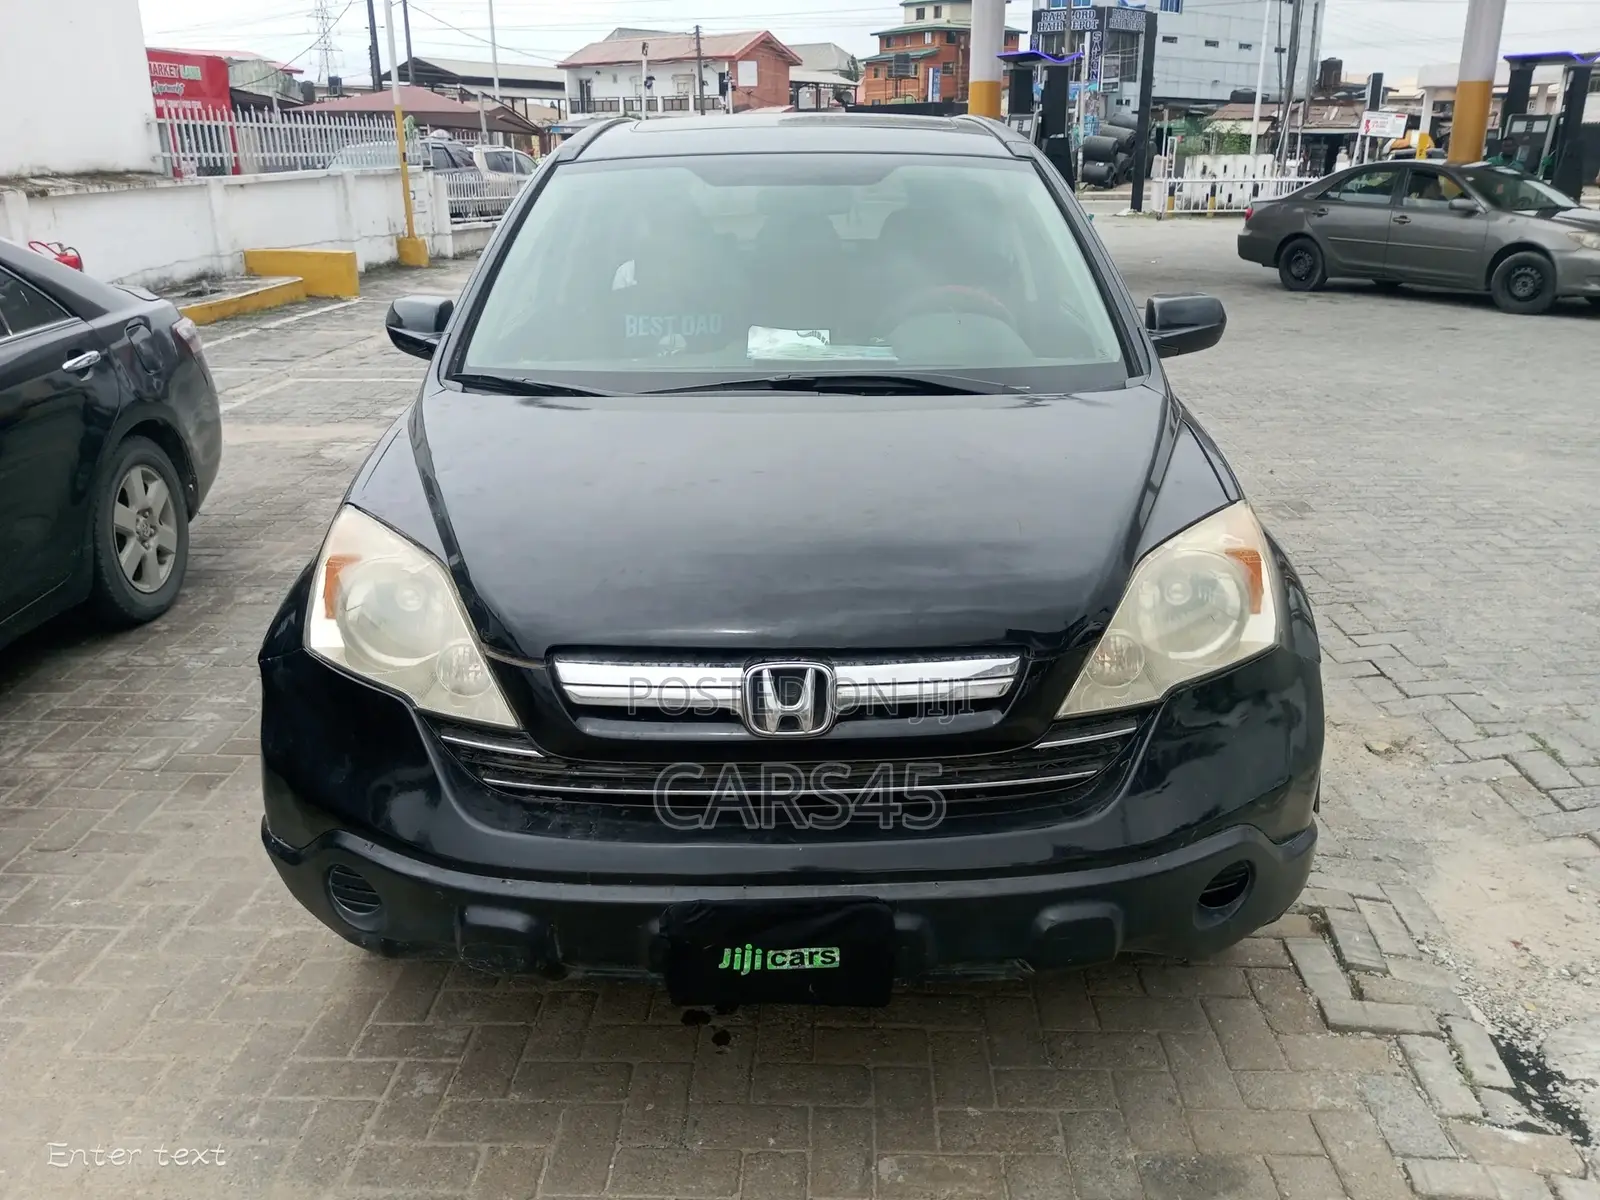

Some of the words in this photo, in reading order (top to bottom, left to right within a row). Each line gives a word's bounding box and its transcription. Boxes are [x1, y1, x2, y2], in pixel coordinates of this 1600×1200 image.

[1037, 21, 1063, 32] HAIR
[1066, 19, 1099, 31] EPOT
[1041, 10, 1096, 21] BABYORD
[1089, 31, 1102, 80] SALON
[625, 314, 675, 338] BEST
[768, 947, 839, 969] cars
